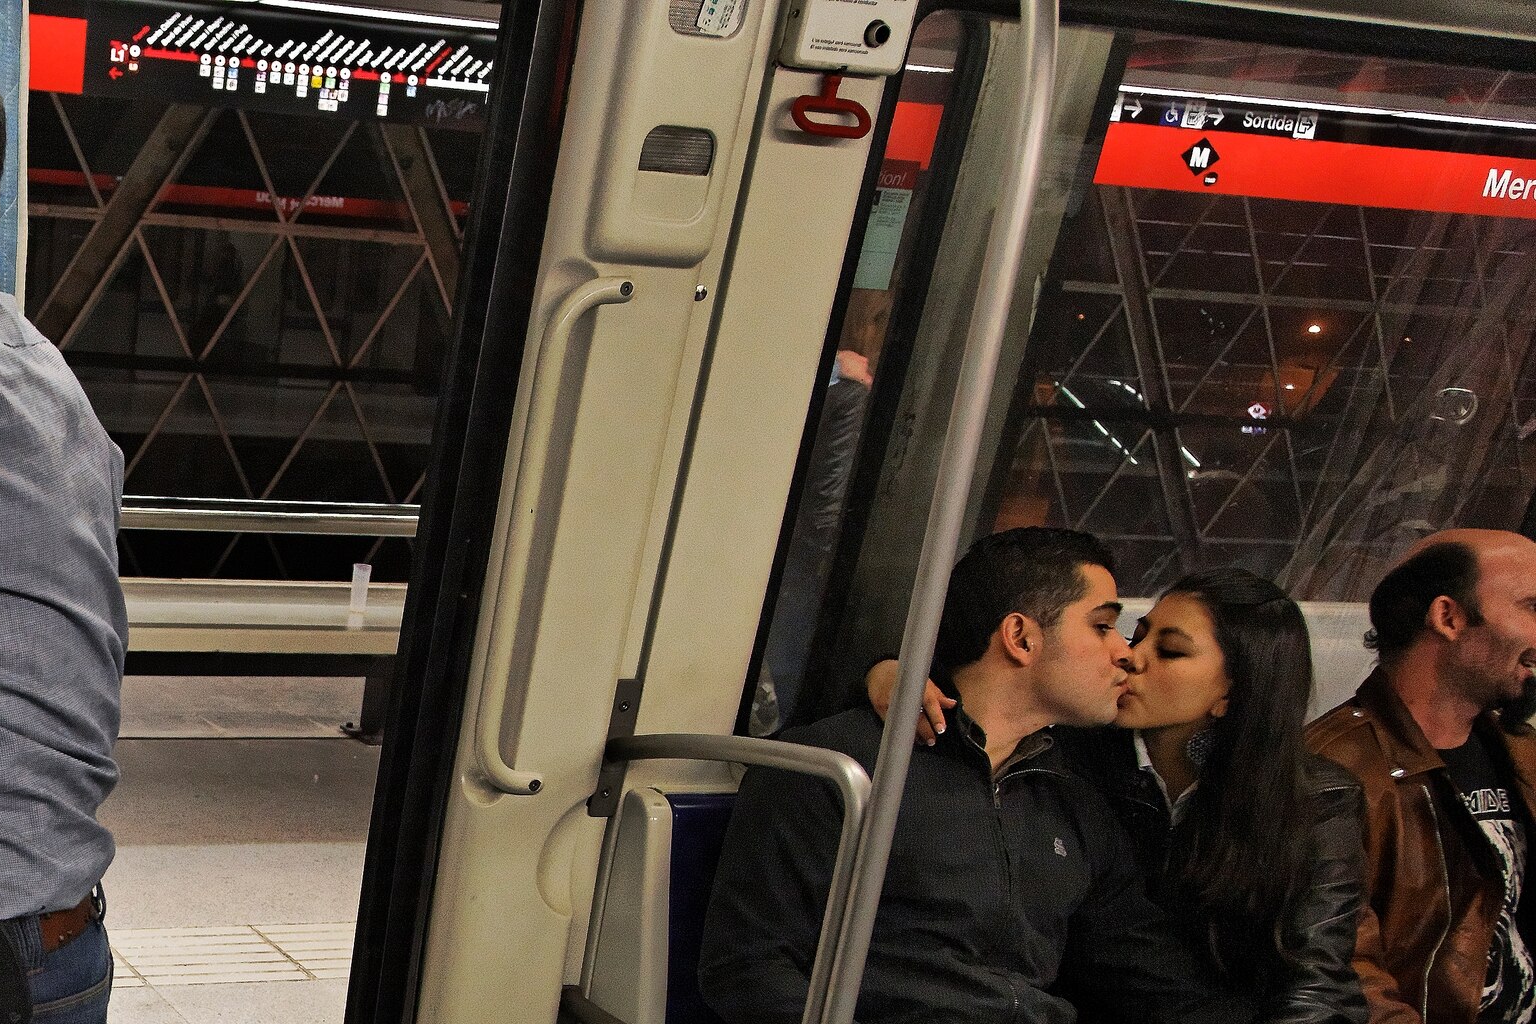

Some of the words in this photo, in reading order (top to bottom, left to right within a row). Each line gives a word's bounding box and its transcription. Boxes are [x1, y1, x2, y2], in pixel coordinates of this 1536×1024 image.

[110, 48, 124, 62] L1
[1242, 111, 1293, 132] Sortida
[1189, 146, 1211, 168] M
